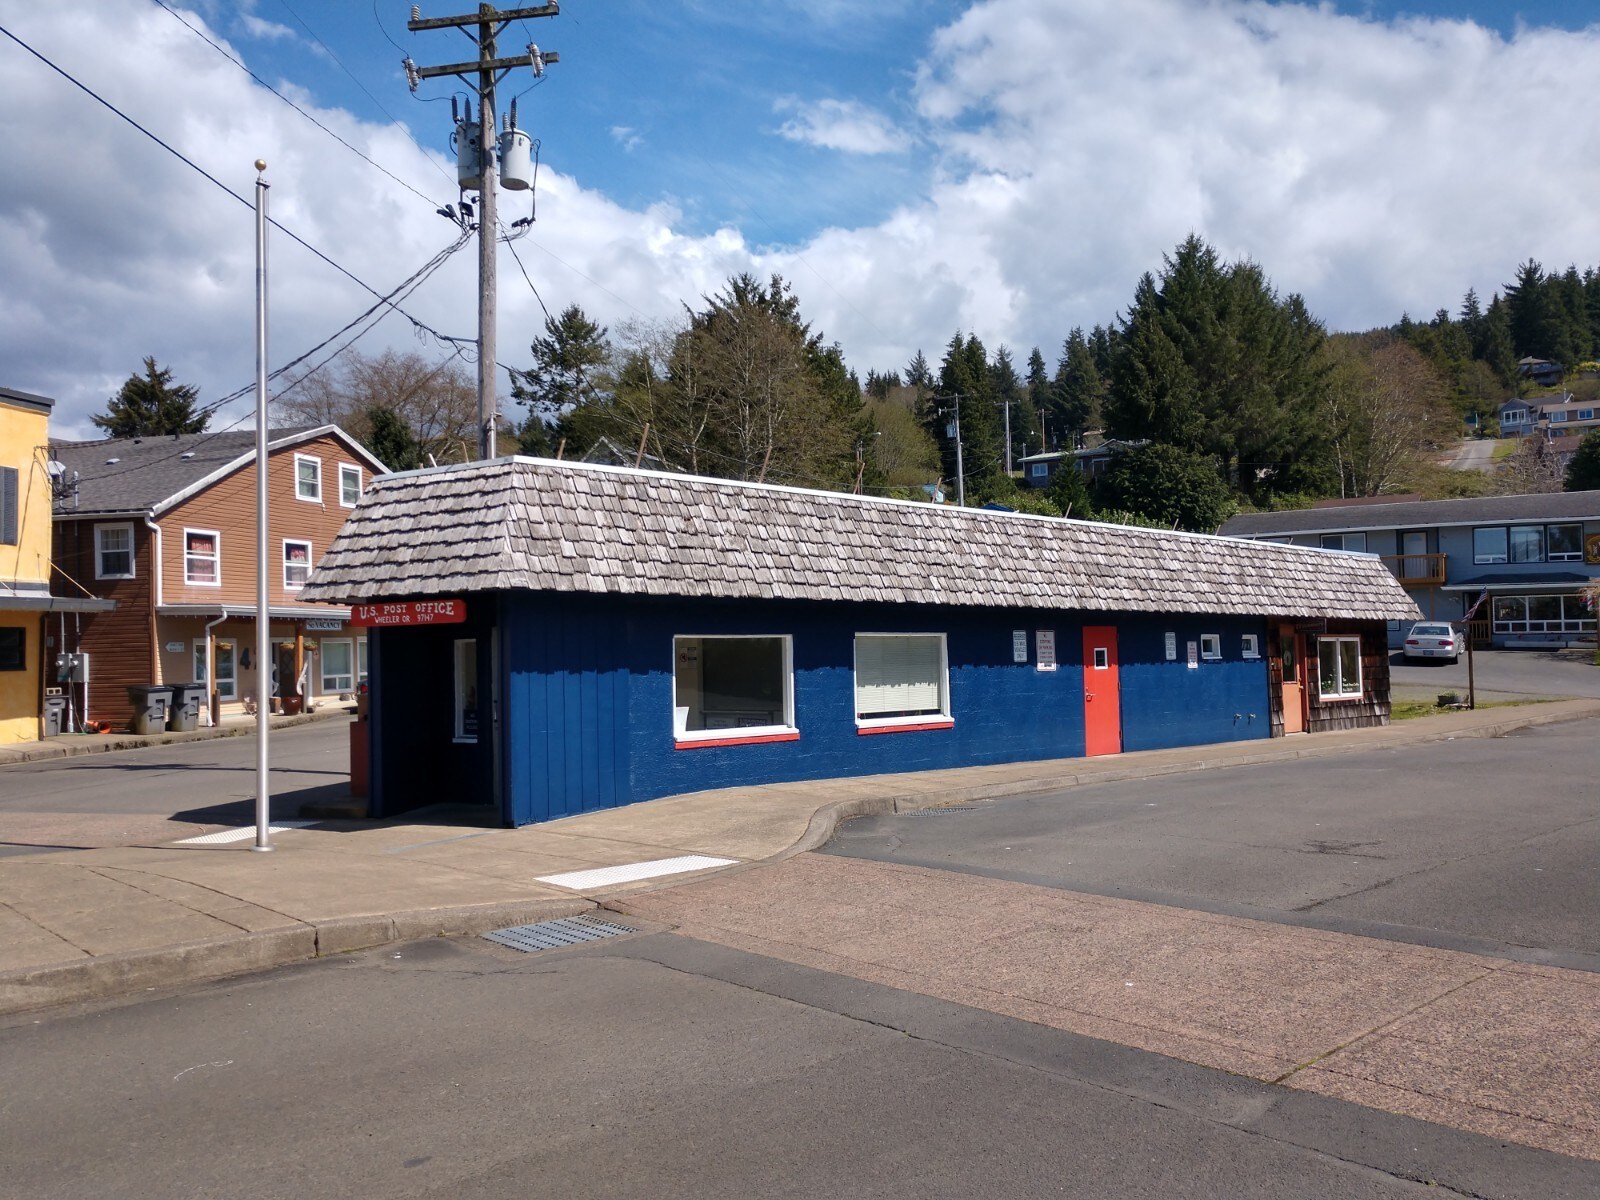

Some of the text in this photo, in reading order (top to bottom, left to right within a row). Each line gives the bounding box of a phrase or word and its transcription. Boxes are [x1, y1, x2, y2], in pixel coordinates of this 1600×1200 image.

[359, 602, 455, 619] U.S. POST OFFICE
[374, 613, 434, 624] WHEELER OR 97147
[315, 621, 340, 629] VACANCY
